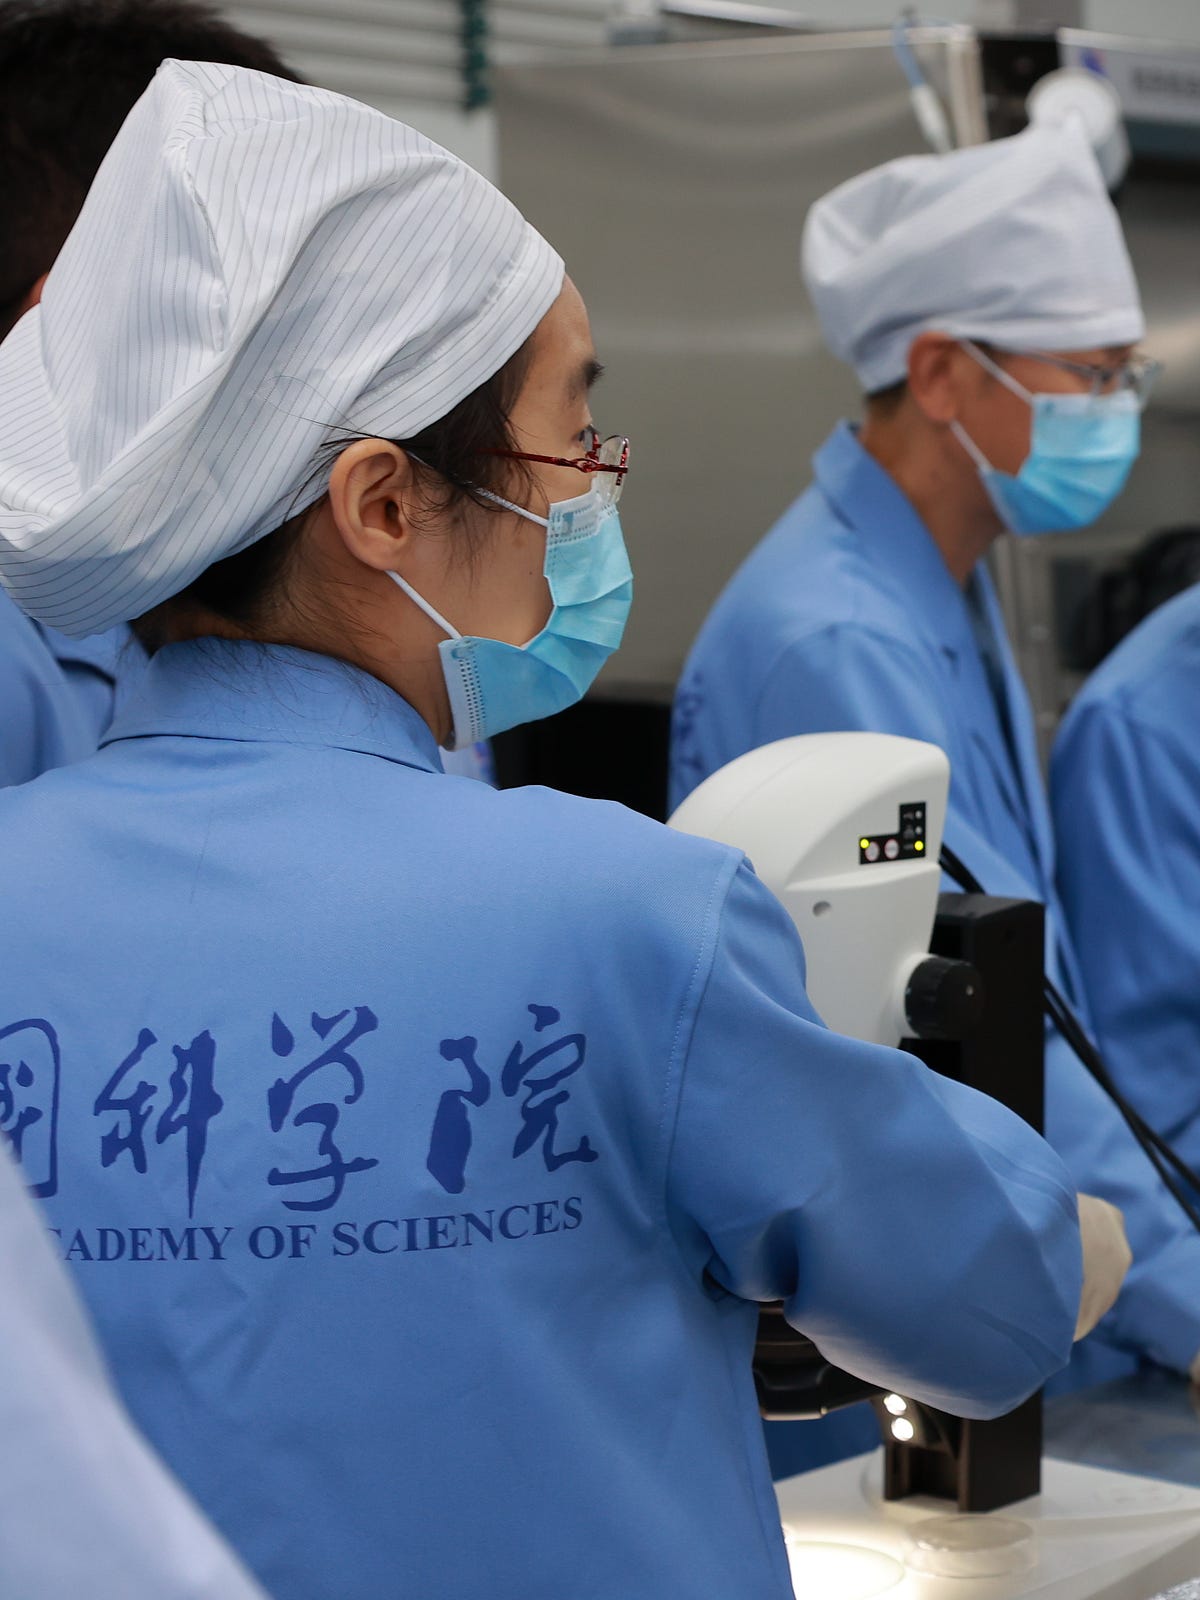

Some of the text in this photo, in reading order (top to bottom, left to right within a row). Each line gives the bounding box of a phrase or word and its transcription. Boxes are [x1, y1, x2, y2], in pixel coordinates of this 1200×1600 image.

[48, 1196, 584, 1261] ADEMY OF SCIENCES
